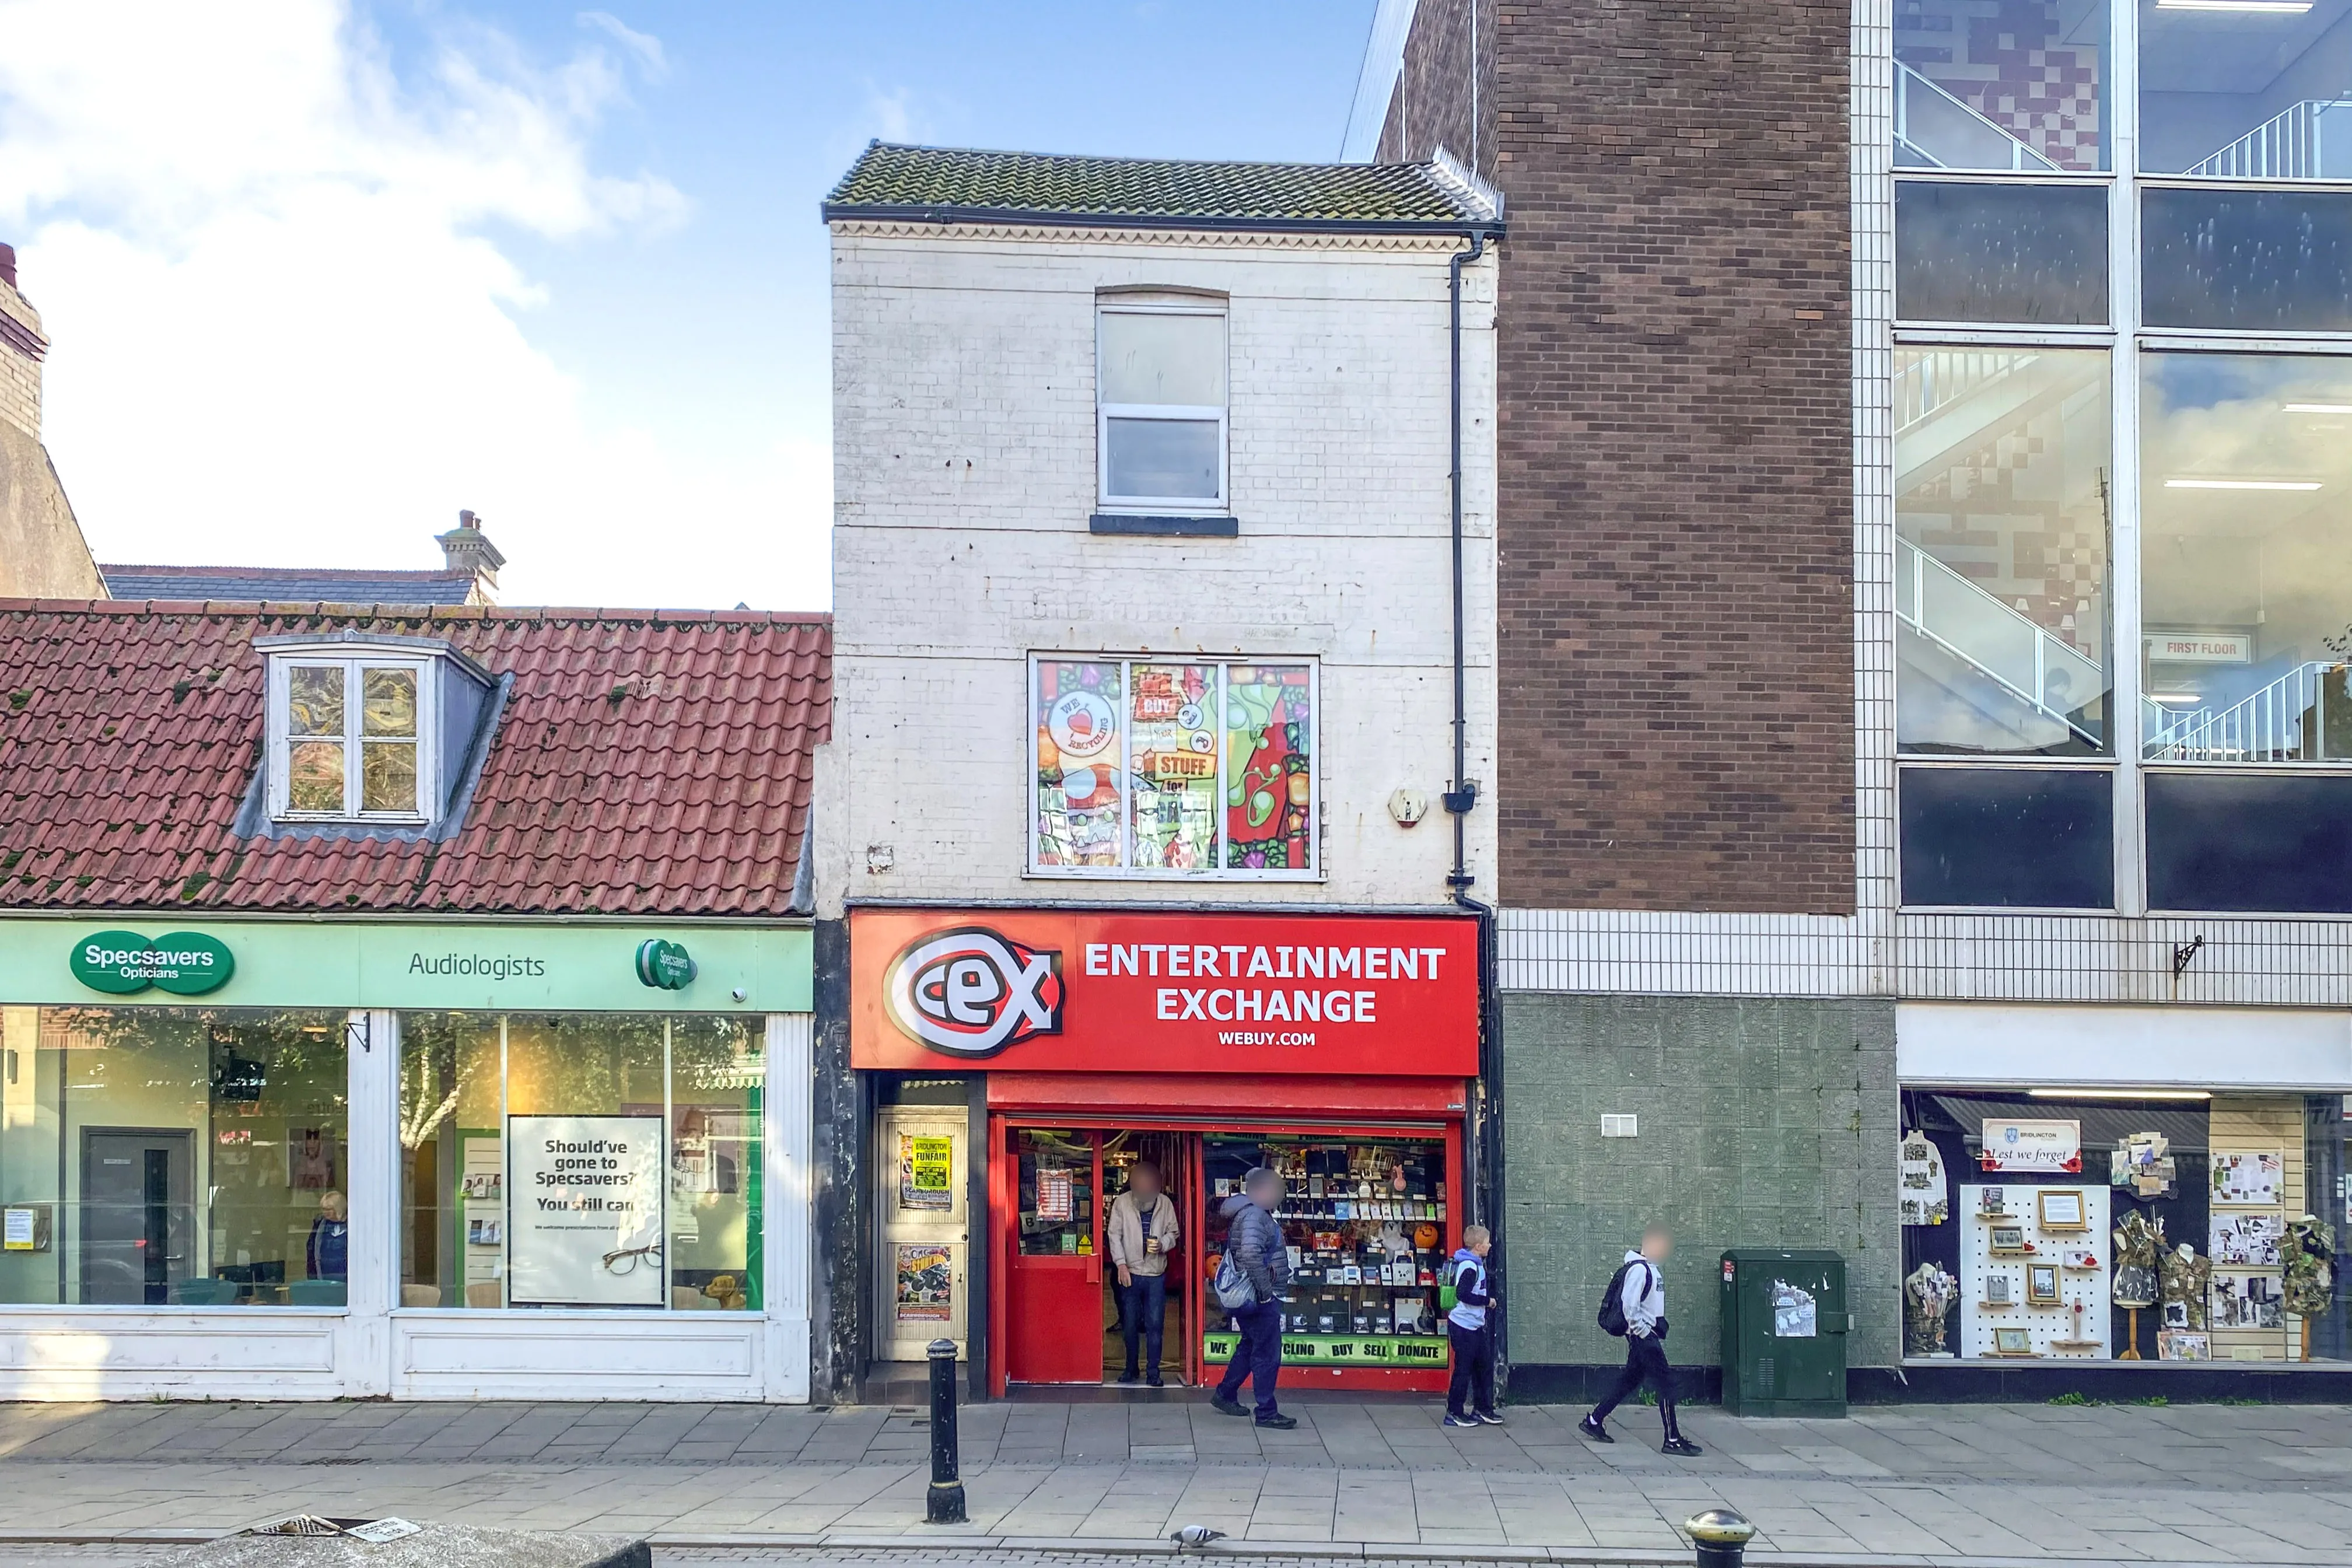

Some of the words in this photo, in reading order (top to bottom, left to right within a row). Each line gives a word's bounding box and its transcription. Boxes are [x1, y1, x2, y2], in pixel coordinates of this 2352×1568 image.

[2167, 642, 2198, 654] FIRST
[2202, 643, 2236, 654] FLOOR
[1060, 698, 1080, 714] WE
[1144, 699, 1170, 713] BUY
[1068, 718, 1108, 750] RECYCLING
[1154, 729, 1172, 740] YOUR
[1161, 756, 1207, 775] STUFF
[1166, 781, 1183, 791] for
[85, 944, 214, 968] Specsavers
[659, 949, 688, 969] Specsavers
[1085, 943, 1447, 981] ENTERTAINMENT
[120, 966, 178, 979] Opticians
[408, 953, 545, 981] Audiologists
[1157, 988, 1377, 1023] EXCHANGE
[1218, 1031, 1317, 1046] WEBUY.COM
[545, 1140, 627, 1153] Should've
[916, 1153, 947, 1161] FUNFAIR
[2033, 1149, 2067, 1163] forget
[555, 1158, 596, 1172] gone
[601, 1157, 617, 1169] to
[536, 1172, 637, 1187] Specsavers?
[537, 1198, 568, 1211] You
[572, 1198, 602, 1211] still
[1210, 1342, 1227, 1354] WE
[1332, 1343, 1353, 1356] BUY
[1364, 1344, 1387, 1357] SELL
[1398, 1345, 1438, 1358] DONATE
